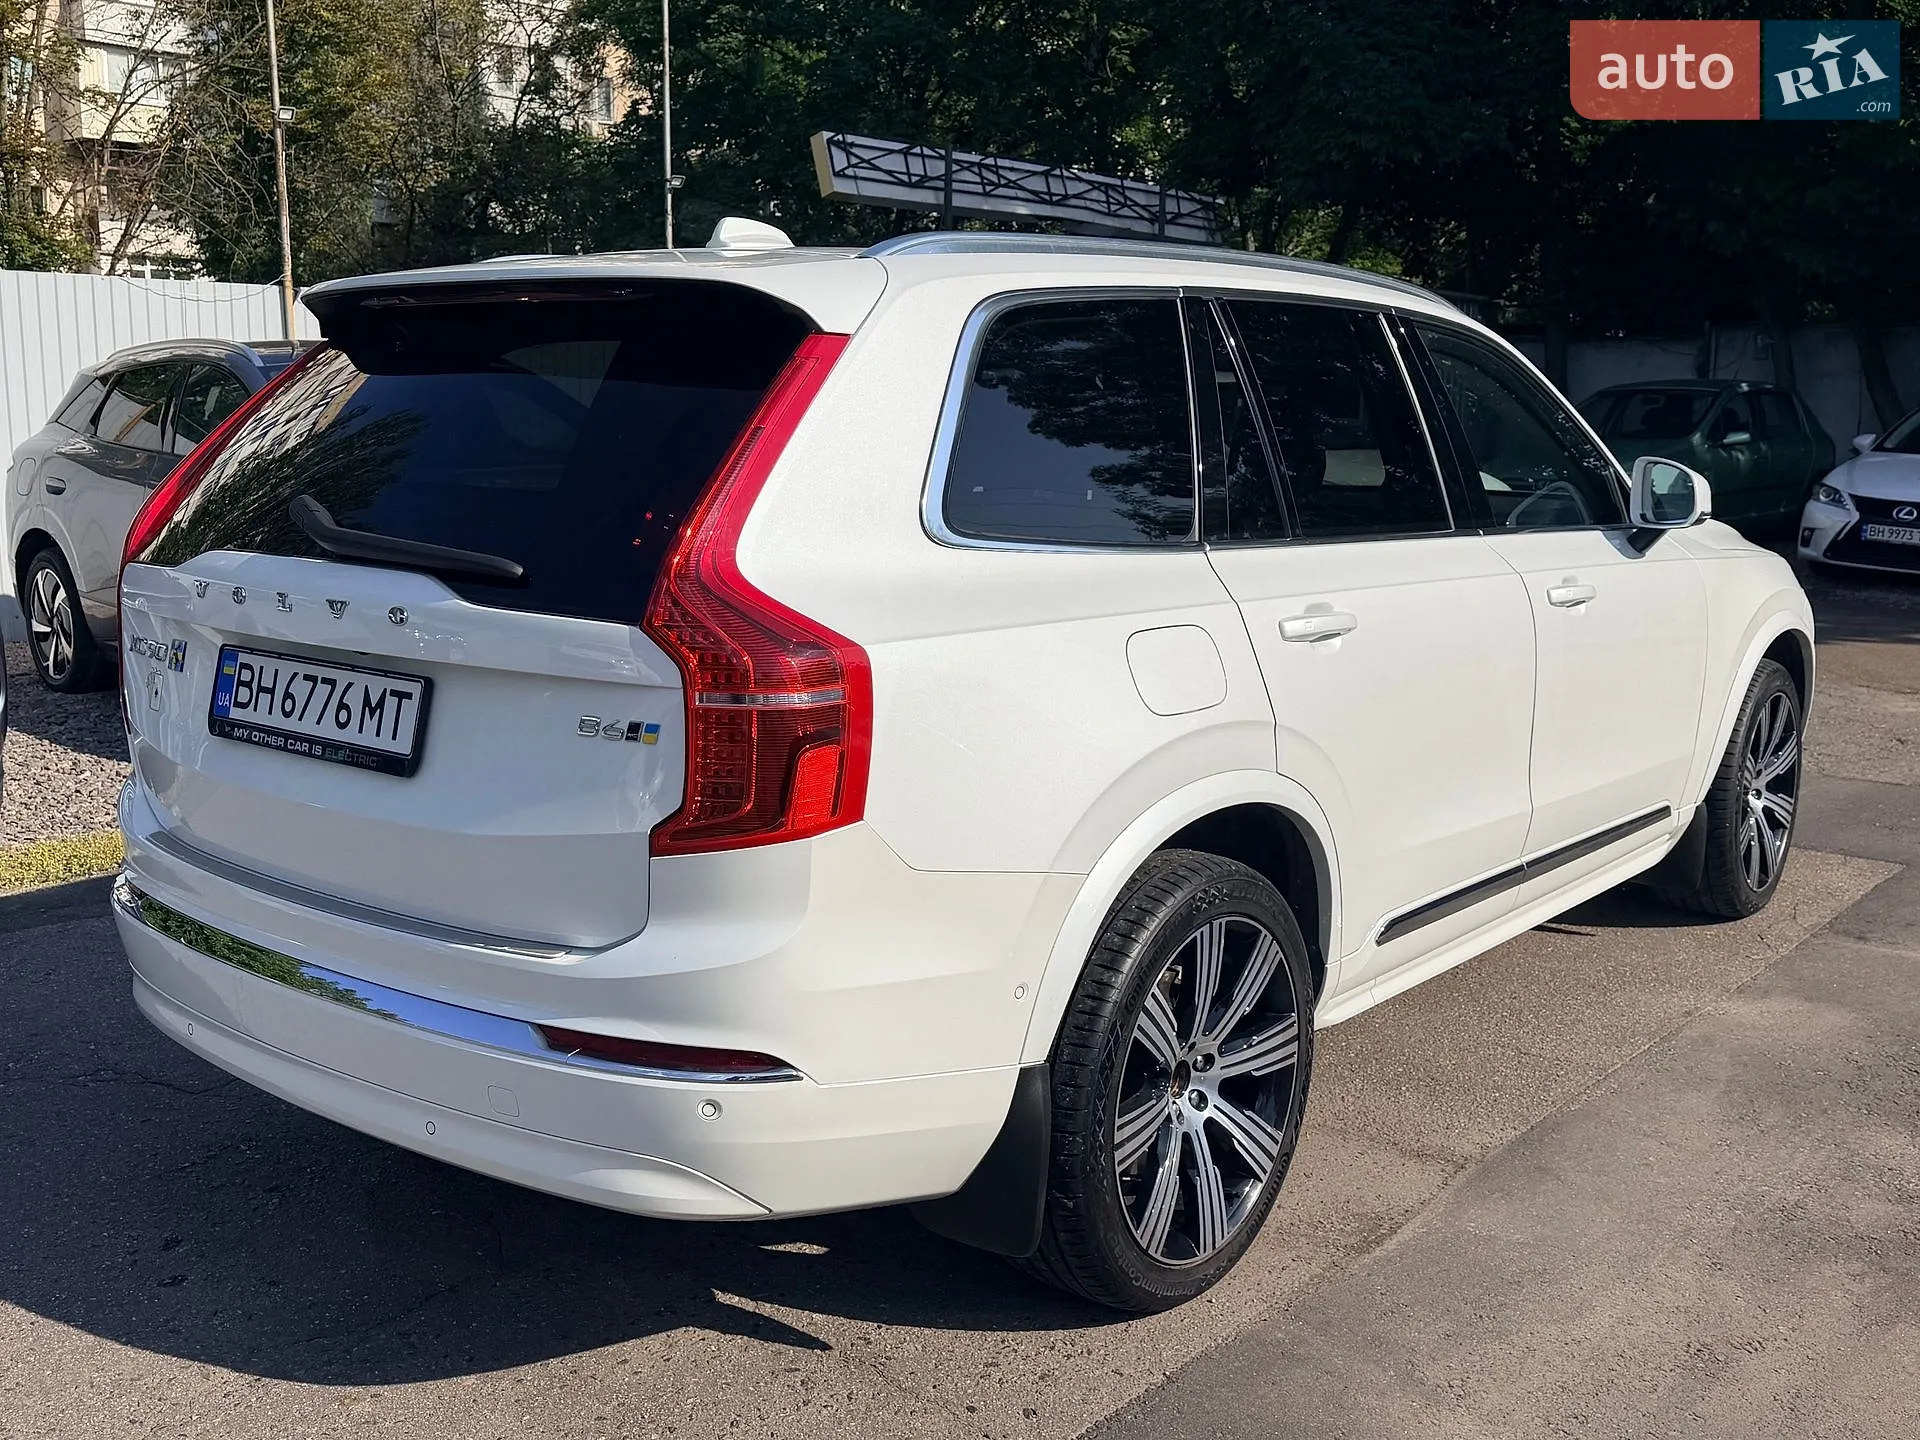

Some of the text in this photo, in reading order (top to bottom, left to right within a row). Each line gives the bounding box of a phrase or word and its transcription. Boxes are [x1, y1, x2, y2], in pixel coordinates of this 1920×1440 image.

[1869, 525, 1886, 538] BH
[194, 579, 409, 627] VOLVO
[129, 634, 168, 662] XC90
[217, 691, 230, 707] UA
[232, 661, 414, 741] BH 6776 MT
[577, 715, 625, 741] B6
[233, 727, 377, 767] MY OTHER CAR IS ELECTRIC
